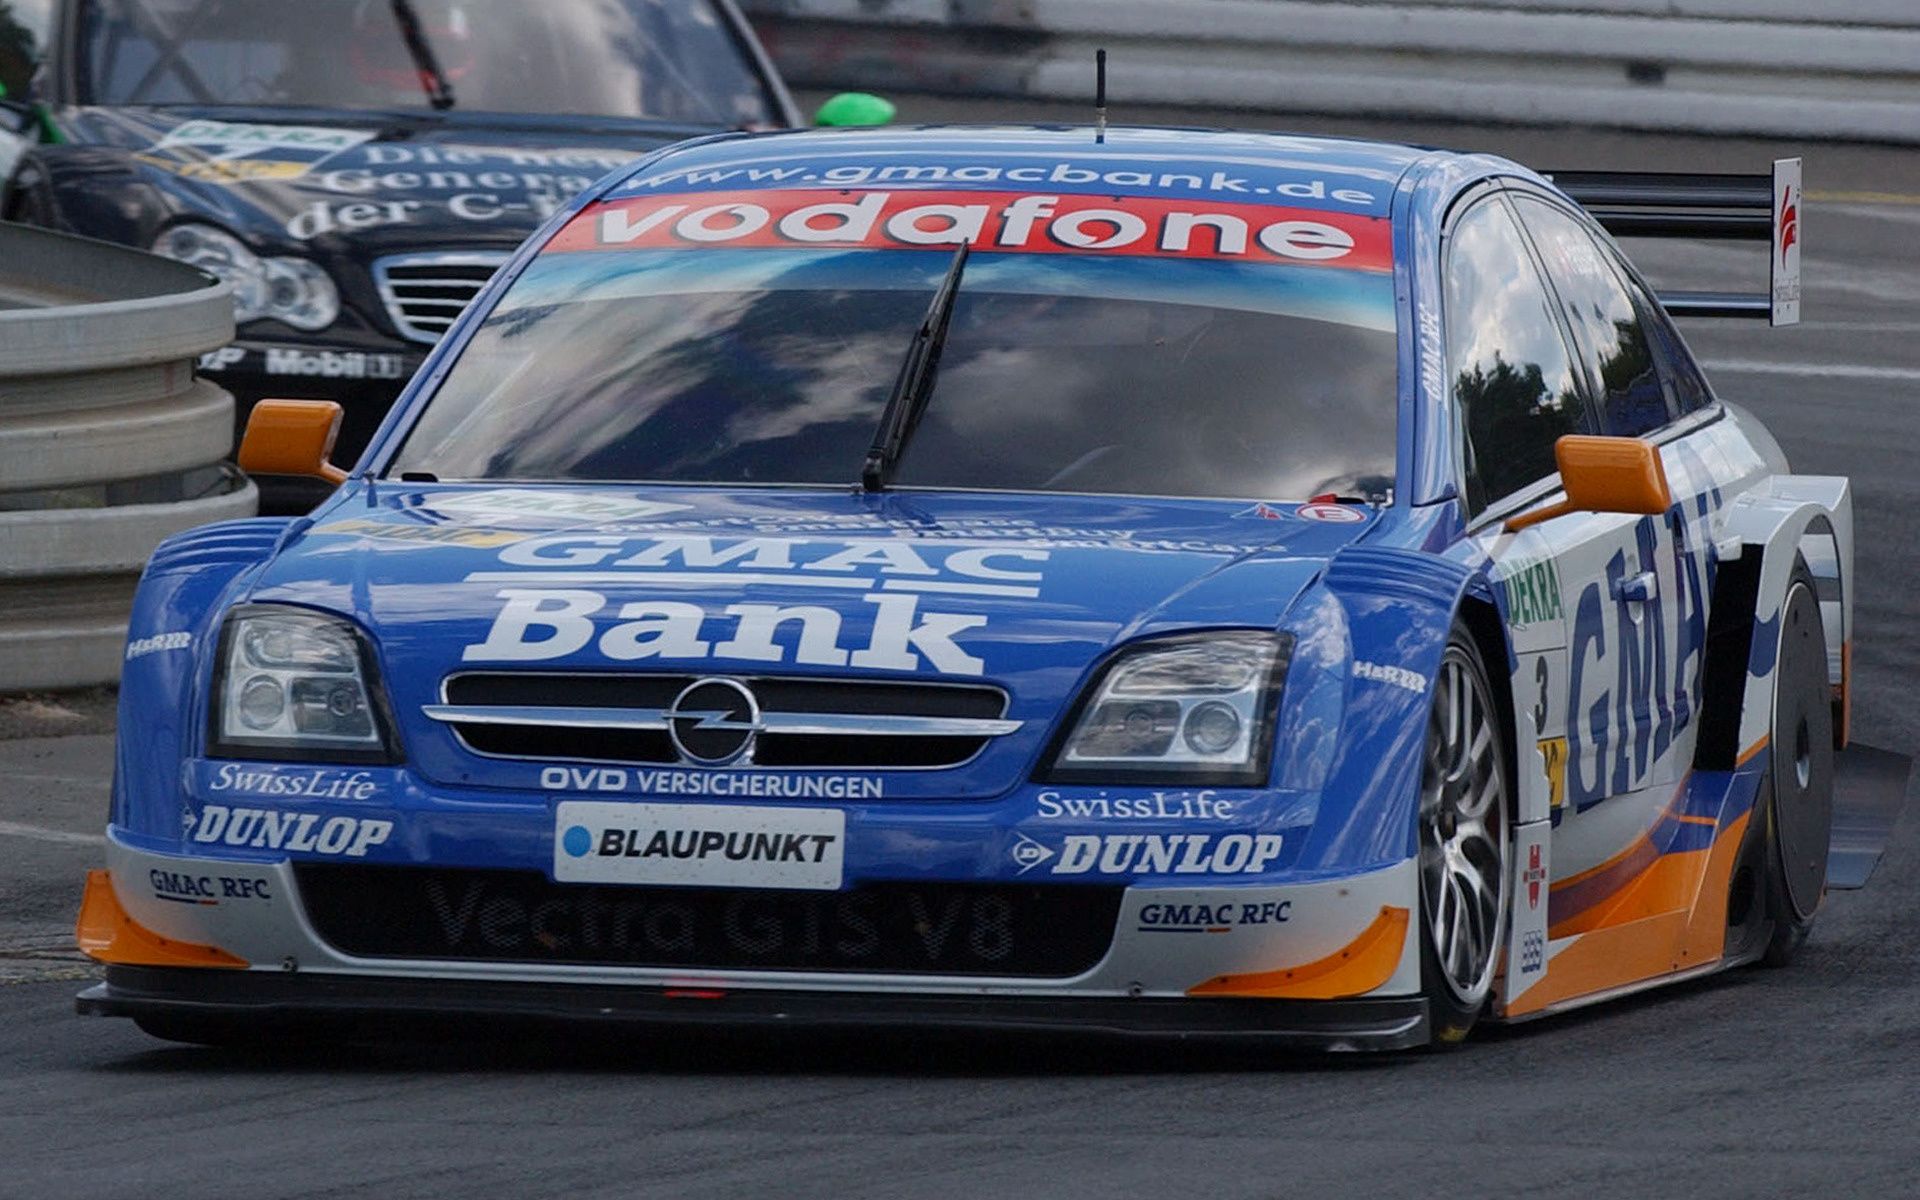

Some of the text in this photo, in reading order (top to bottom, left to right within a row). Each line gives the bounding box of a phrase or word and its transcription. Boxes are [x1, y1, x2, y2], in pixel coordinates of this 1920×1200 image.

[365, 146, 483, 164] Die
[626, 162, 1376, 206] www.gmacbank.de
[286, 200, 424, 241] der
[602, 192, 1356, 260] vodafone
[265, 349, 366, 378] Mobil
[498, 535, 1053, 581] GMAC
[1504, 558, 1565, 627] DEKRA
[463, 588, 988, 677] Bank
[1534, 655, 1548, 736] 3
[210, 763, 377, 801] SwissLife
[540, 767, 883, 799] OVD VERSICHERUNGEN
[1037, 790, 1236, 820] SwissLife
[194, 805, 394, 858] DUNLOP
[597, 828, 836, 864] BLAUPUNKT
[1051, 834, 1284, 874] DUNLOP
[149, 868, 271, 901] GMAC RFC
[427, 880, 696, 954] Vectra
[910, 893, 1013, 961] V8
[1139, 901, 1292, 926] GMAC RFC
